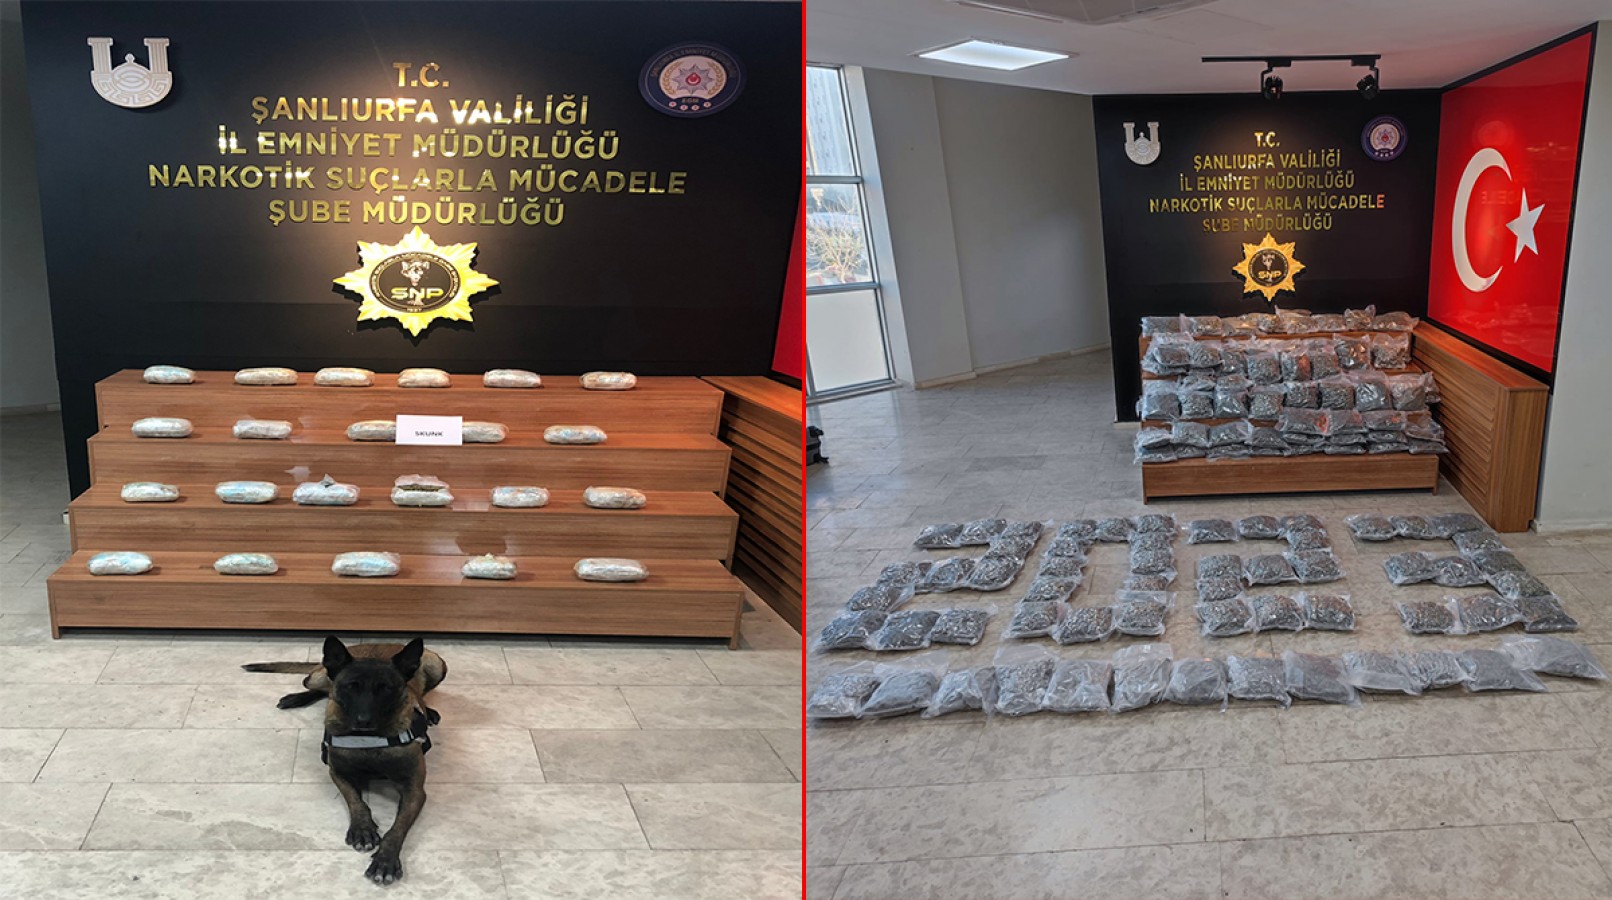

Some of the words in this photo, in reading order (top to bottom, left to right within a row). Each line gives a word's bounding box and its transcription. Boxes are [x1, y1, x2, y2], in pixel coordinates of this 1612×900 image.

[392, 62, 450, 88] T.C.
[251, 95, 439, 125] ŞANLIURFA
[449, 94, 589, 125] VALİLİĞİ
[218, 124, 247, 155] İL
[257, 126, 402, 156] EMNİYET
[412, 128, 620, 160] MÜDÜRLÜĞÜ
[1193, 153, 1276, 173] ŞANLIURFA
[1279, 148, 1341, 169] VALİLİĞİ
[148, 160, 316, 189] NARKOTİK
[326, 166, 498, 194] SUÇLARLA
[509, 164, 688, 194] MÜCADELE
[1180, 172, 1193, 191] İL
[1197, 172, 1260, 191] EMNİYET
[1264, 169, 1355, 190] MÜDÜRLÜĞÜ
[269, 199, 351, 226] ŞUBE
[362, 195, 565, 226] MÜDÜRLÜĞÜ
[1149, 194, 1223, 213] NARKOTİK
[1227, 196, 1302, 214] SUÇLARLA
[1306, 191, 1386, 210] MÜCADELE
[1243, 212, 1332, 232] MÜDÜRLÜĞÜ
[391, 287, 444, 300] SNP
